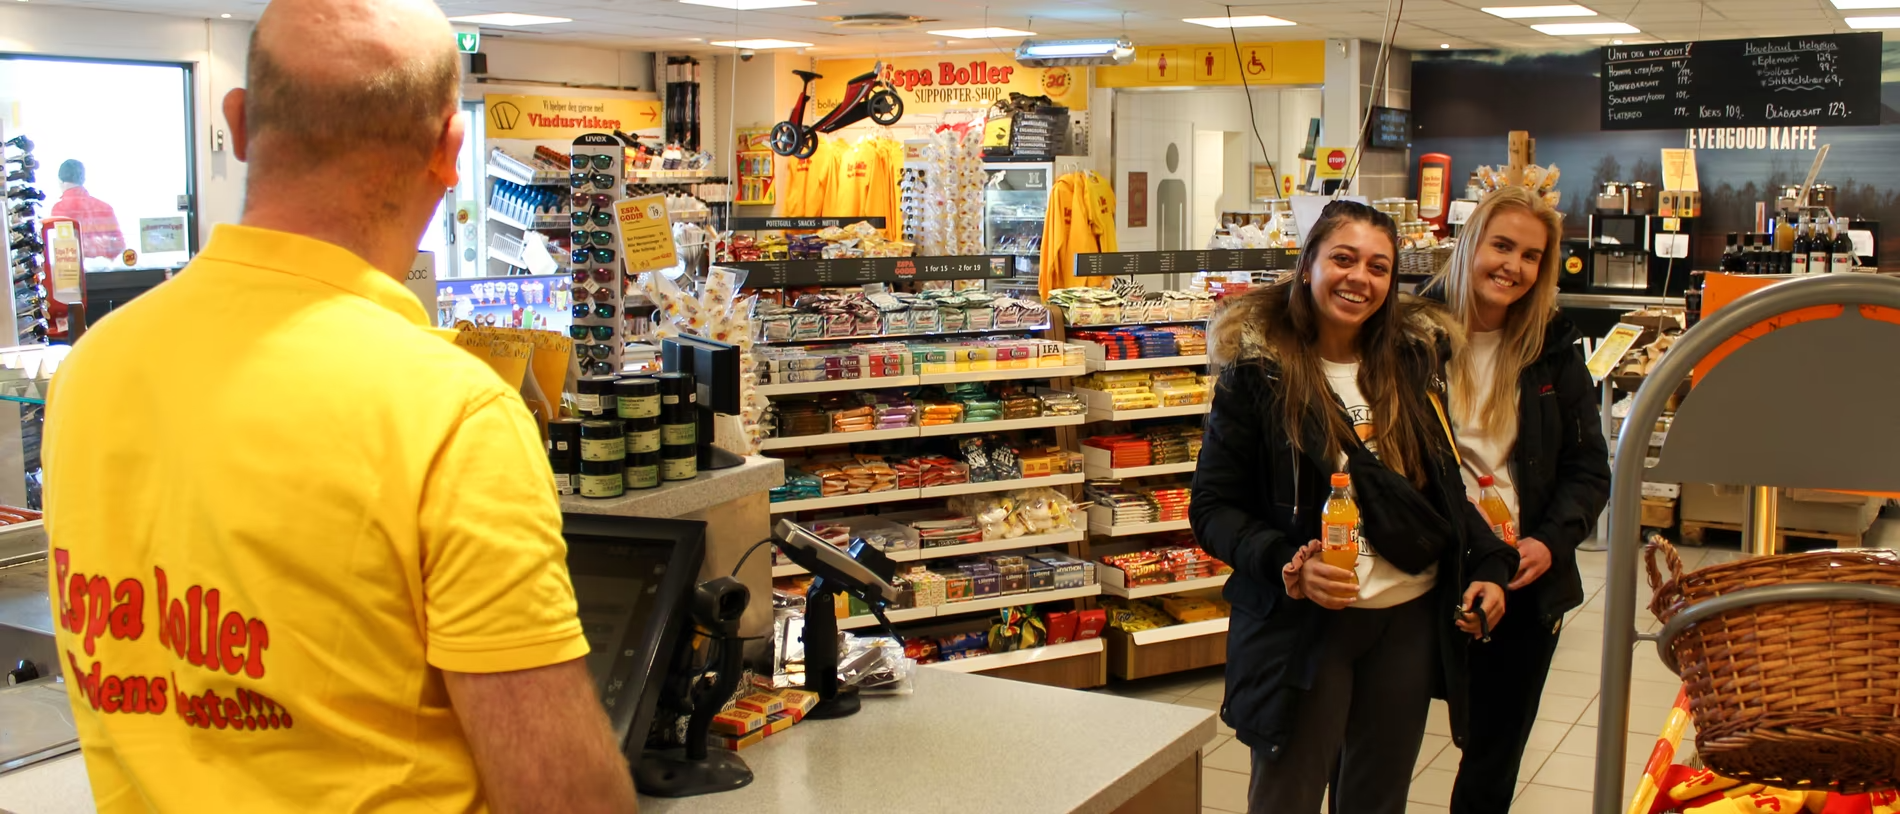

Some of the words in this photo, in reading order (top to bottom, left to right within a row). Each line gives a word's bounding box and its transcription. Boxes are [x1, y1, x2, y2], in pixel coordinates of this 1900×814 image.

[938, 61, 1014, 86] Boller
[915, 87, 1002, 103] SUPPORTER-SHOP
[543, 100, 549, 110] Vi
[550, 101, 567, 112] hjelper
[568, 101, 577, 112] deg
[578, 103, 593, 113] gjerne
[594, 102, 604, 111] med
[527, 113, 621, 129] Vindusviskere
[1689, 127, 1767, 149] EVERGOOD
[1770, 126, 1817, 149] KAFFE
[621, 206, 639, 215] ESPA
[620, 212, 643, 222] GODIS
[930, 264, 940, 272] for
[963, 264, 973, 272] for
[1042, 344, 1060, 354] IFA
[1057, 565, 1081, 573] MYNTHON
[1137, 564, 1156, 576] LION
